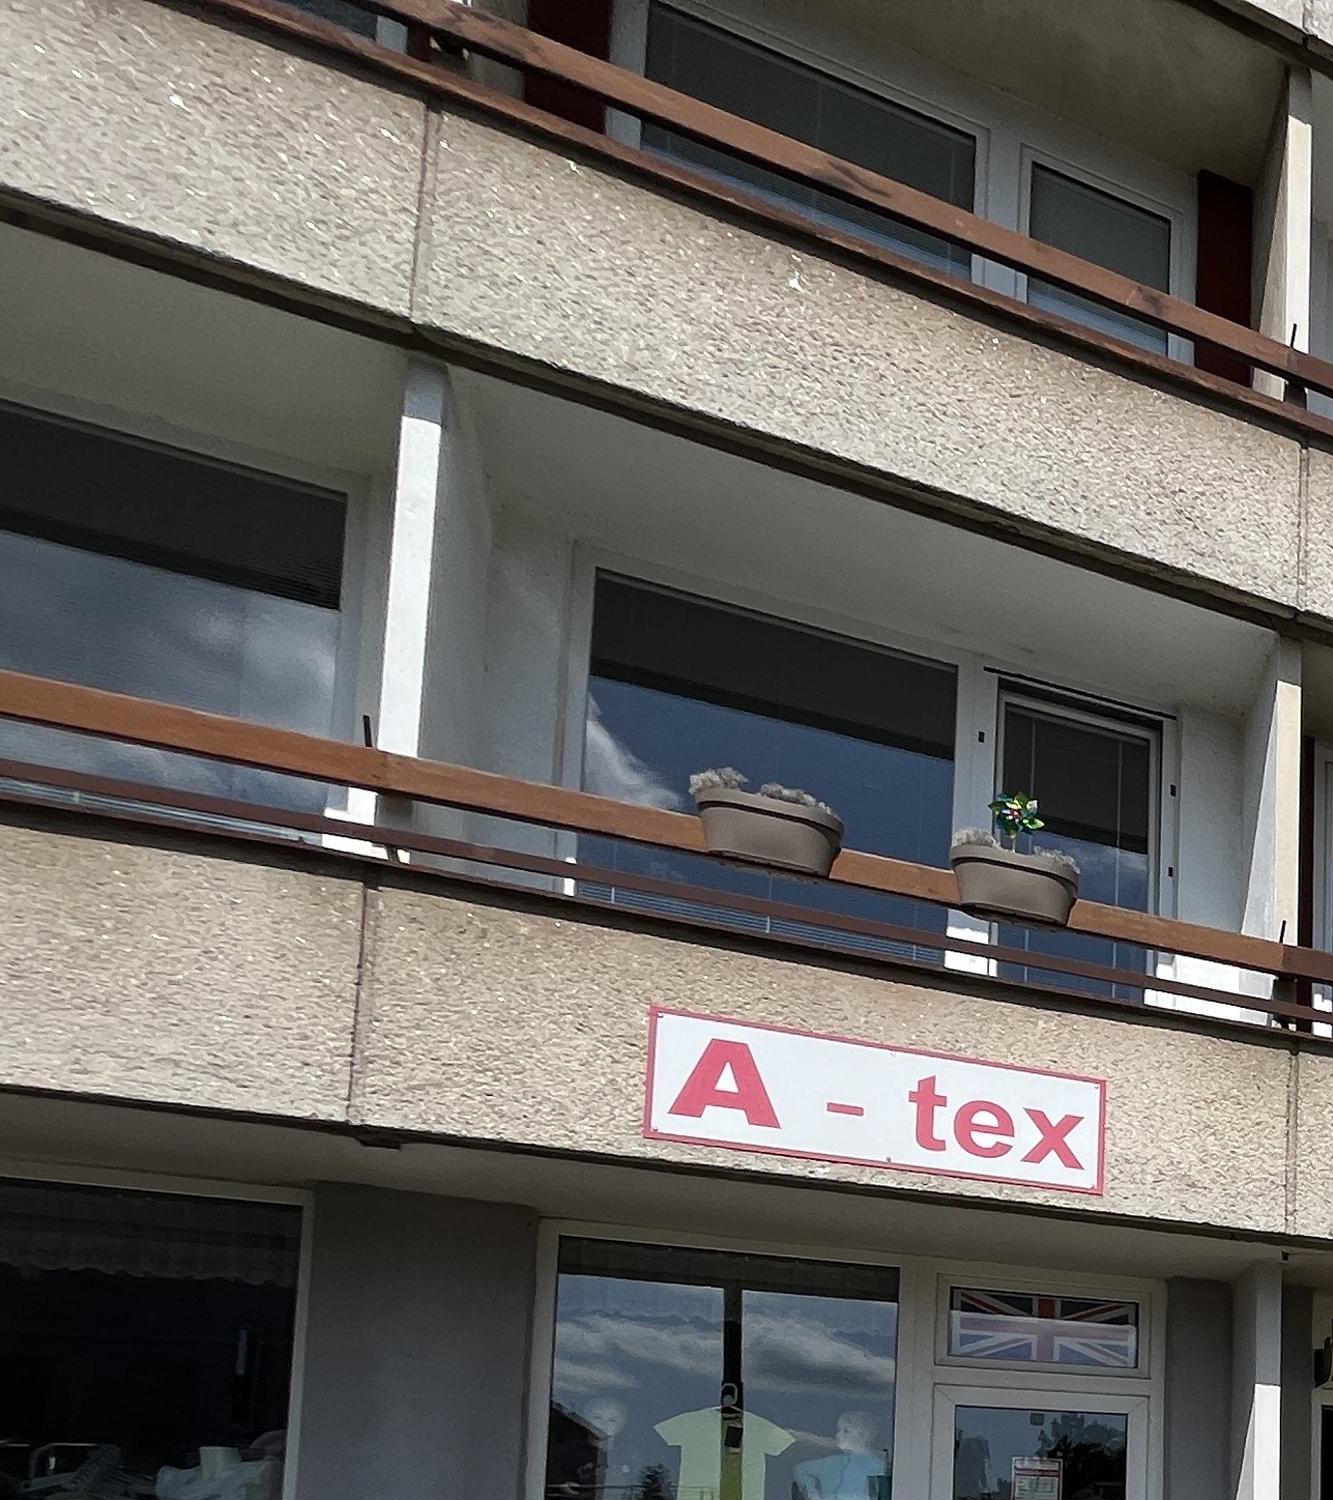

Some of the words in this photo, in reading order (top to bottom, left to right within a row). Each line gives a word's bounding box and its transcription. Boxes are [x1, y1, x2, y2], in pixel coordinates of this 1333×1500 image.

[668, 1038, 781, 1129] A
[826, 1102, 865, 1117] -
[908, 1075, 1084, 1170] tex
